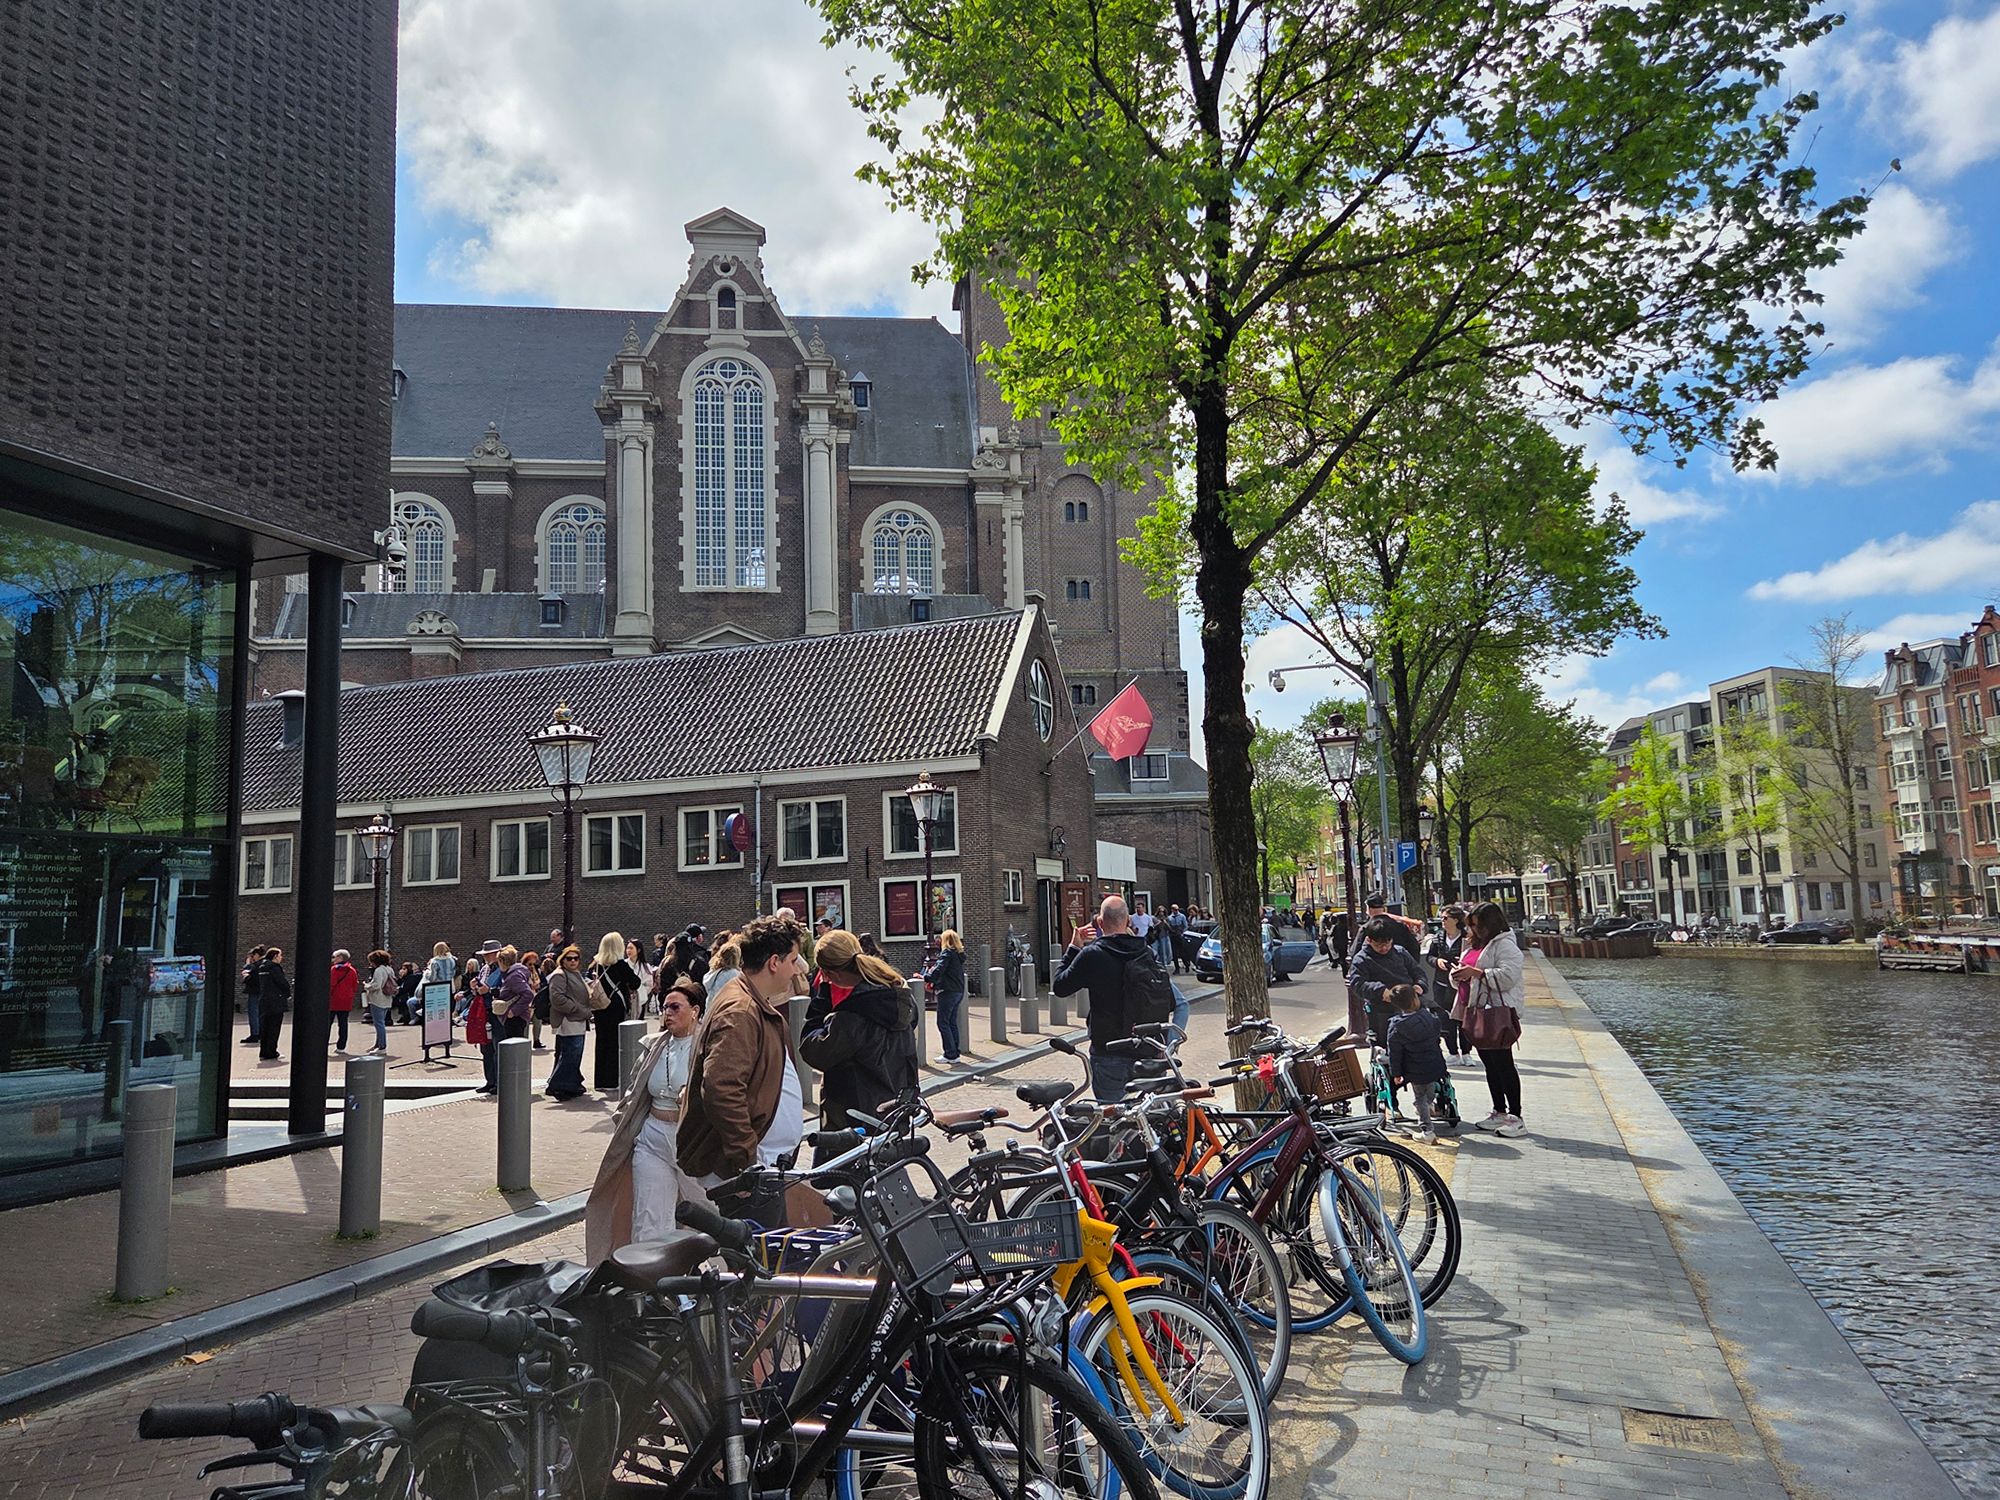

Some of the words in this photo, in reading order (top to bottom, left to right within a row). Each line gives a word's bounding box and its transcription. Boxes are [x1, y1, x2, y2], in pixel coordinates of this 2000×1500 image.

[66, 851, 82, 860] niet
[1402, 850, 1410, 863] P
[31, 863, 46, 872] Het
[46, 863, 68, 874] enige
[50, 874, 64, 883] het
[28, 885, 59, 896] beseffen
[23, 897, 64, 908] vervolging
[8, 910, 38, 918] mensen
[27, 944, 48, 952] what
[48, 942, 85, 953] happened
[29, 955, 50, 965] thing
[62, 955, 77, 963] can
[40, 967, 58, 976] past
